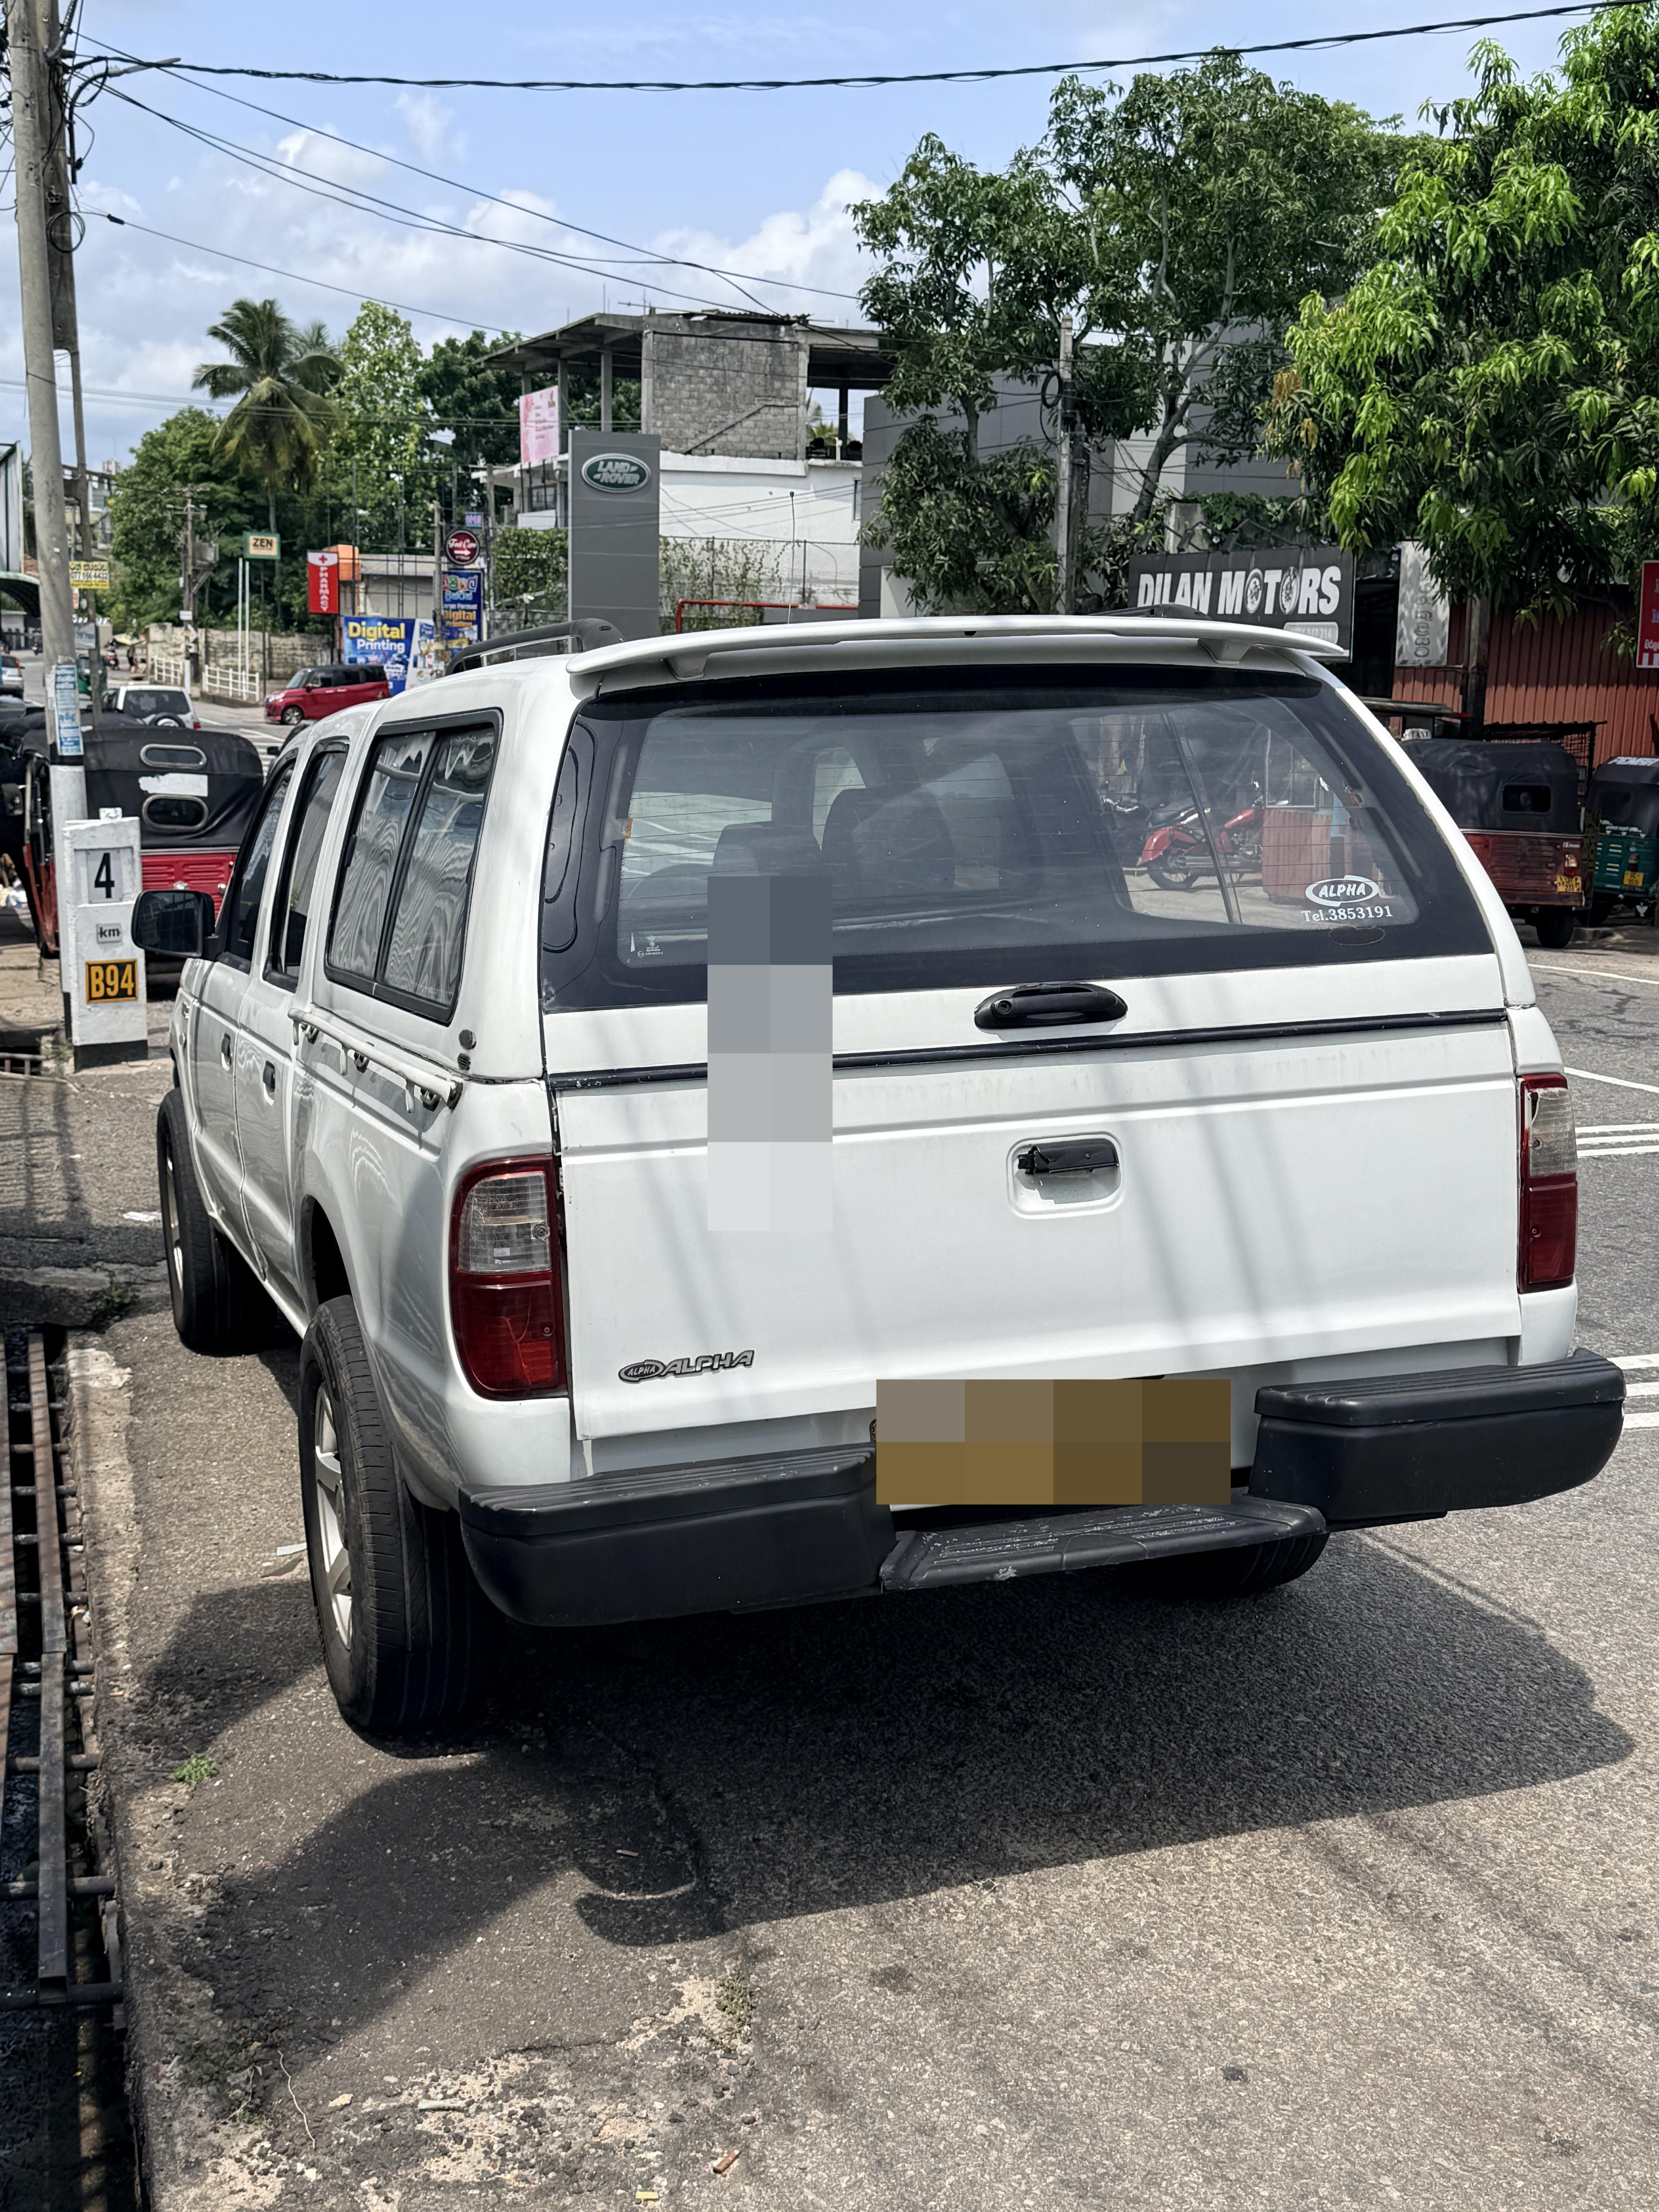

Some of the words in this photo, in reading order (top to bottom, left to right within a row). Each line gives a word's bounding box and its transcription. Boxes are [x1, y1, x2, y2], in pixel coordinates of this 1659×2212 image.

[598, 461, 630, 473] LAND
[600, 472, 639, 484] ROVER
[253, 538, 272, 547] ZEN
[319, 567, 329, 611] PHARMACY
[1137, 572, 1212, 614] DILAN
[1218, 566, 1341, 615] MOTORS
[349, 621, 405, 642] Digital
[357, 639, 405, 653] Printing
[94, 852, 115, 898] 4
[1319, 883, 1366, 898] ALPHA
[1301, 906, 1393, 922] Tel.3853191
[99, 927, 120, 938] km
[91, 964, 134, 998] B94
[627, 1367, 655, 1376] ALPHA
[661, 1350, 754, 1376] ALPHA
